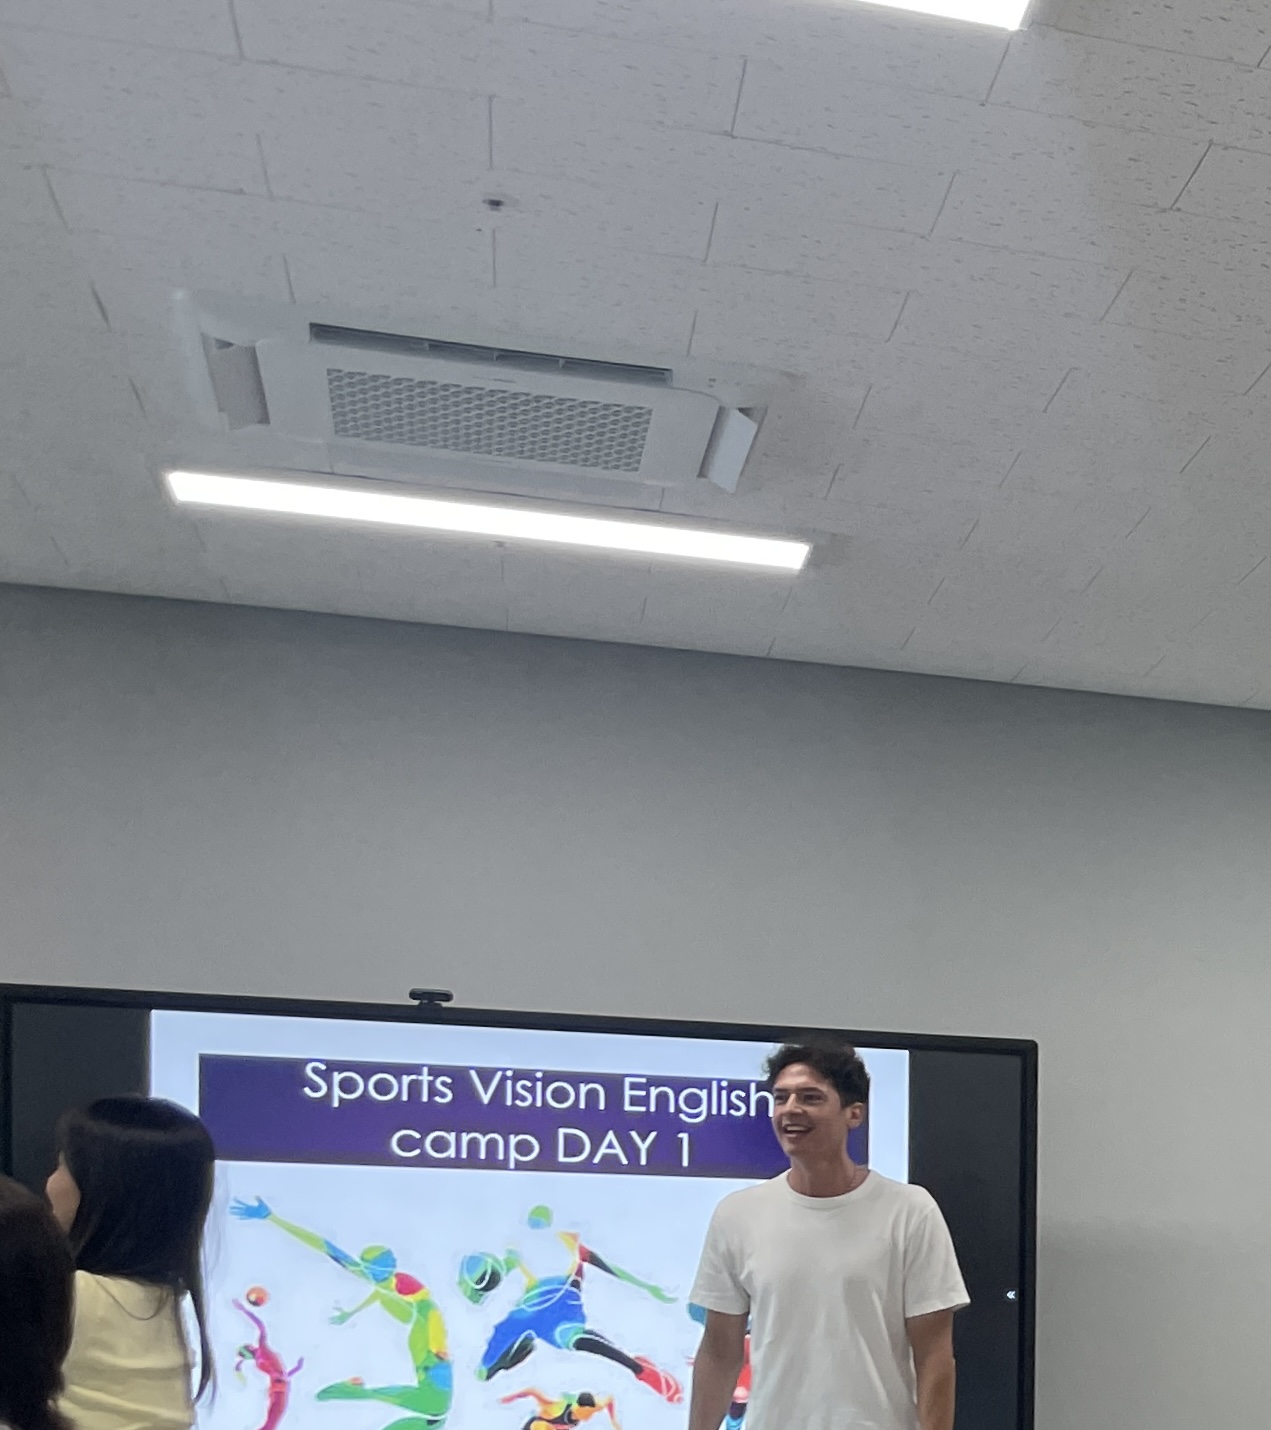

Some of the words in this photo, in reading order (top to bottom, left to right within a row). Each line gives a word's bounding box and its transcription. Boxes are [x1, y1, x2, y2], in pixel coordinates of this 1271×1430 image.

[302, 1061, 454, 1108] Sports
[469, 1069, 607, 1111] Vision
[623, 1076, 775, 1123] English
[391, 1129, 541, 1170] camp
[557, 1127, 658, 1166] DAY
[677, 1132, 690, 1168] 1
